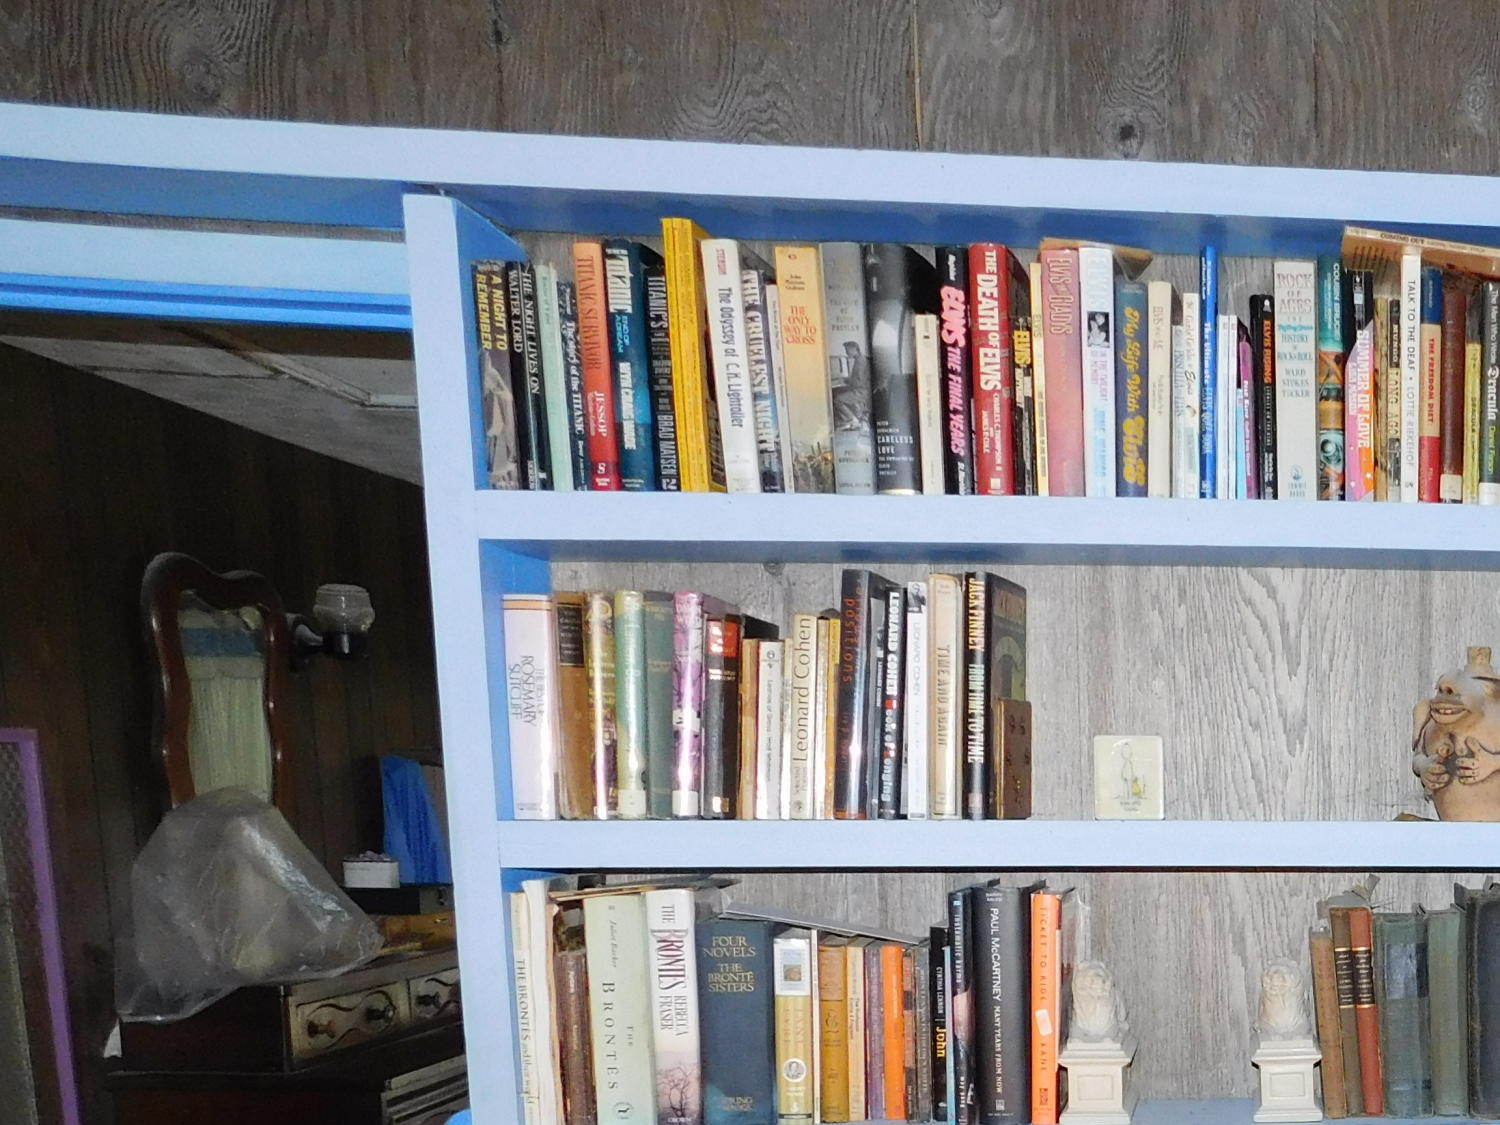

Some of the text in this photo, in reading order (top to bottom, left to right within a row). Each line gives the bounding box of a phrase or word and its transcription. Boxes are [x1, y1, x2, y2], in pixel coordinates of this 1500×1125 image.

[1046, 258, 1072, 284] ELVIS
[476, 274, 491, 350] REMEMBER
[491, 275, 507, 350] A NIGHT TO
[509, 270, 523, 352] WALTER LORD
[576, 256, 601, 370] TITANIC SURVIVOR
[647, 276, 668, 328] TITANIC'S
[976, 251, 1001, 390] THE DEATH OF ELVIS
[1048, 295, 1074, 335] GLADYS
[1490, 306, 1498, 322] Man
[522, 272, 540, 395] THE NIGHT LIVES ON
[718, 287, 744, 428] The Odyssey of Lightoller
[741, 270, 775, 451] THE CRUELEST NIGHT
[1014, 330, 1030, 366] ELVIS
[1120, 307, 1141, 411] My Life With
[1263, 320, 1272, 383] ELVIS RISING
[1406, 280, 1415, 417] TALK TO THE DEAF LOTTIE
[1203, 342, 1211, 384] Ultimate
[1357, 330, 1371, 448] SUMMER OF LOVE
[572, 393, 585, 434] TITANIC
[594, 391, 608, 437] JESSOP
[947, 346, 965, 454] THE FINAL YEARS
[1486, 366, 1499, 420] Dracula
[658, 415, 677, 475] BRAD MATSEN
[878, 446, 895, 454] LOVE
[842, 599, 856, 683] positions
[968, 579, 985, 652] JACK FINNEY
[886, 591, 900, 696] LEONARD COHEN
[936, 645, 950, 675] TIME
[508, 664, 522, 719] SUTCLIFF
[520, 655, 537, 727] ROSEMARY
[792, 618, 811, 762] Leonard Cohen
[937, 679, 949, 705] AND
[967, 664, 984, 764] FROM TIME TO TIME
[662, 904, 676, 924] THE
[712, 936, 748, 946] FOUR
[516, 960, 526, 984] THE
[702, 947, 757, 957] NOVELS
[717, 963, 743, 972] THE
[990, 908, 1001, 1001] PAUL McCARTNEY
[1040, 955, 1047, 968] TO
[659, 996, 673, 1030] FRASER
[708, 982, 754, 992] SISTERS
[675, 995, 688, 1036] REBECCA
[935, 1026, 946, 1058] John
